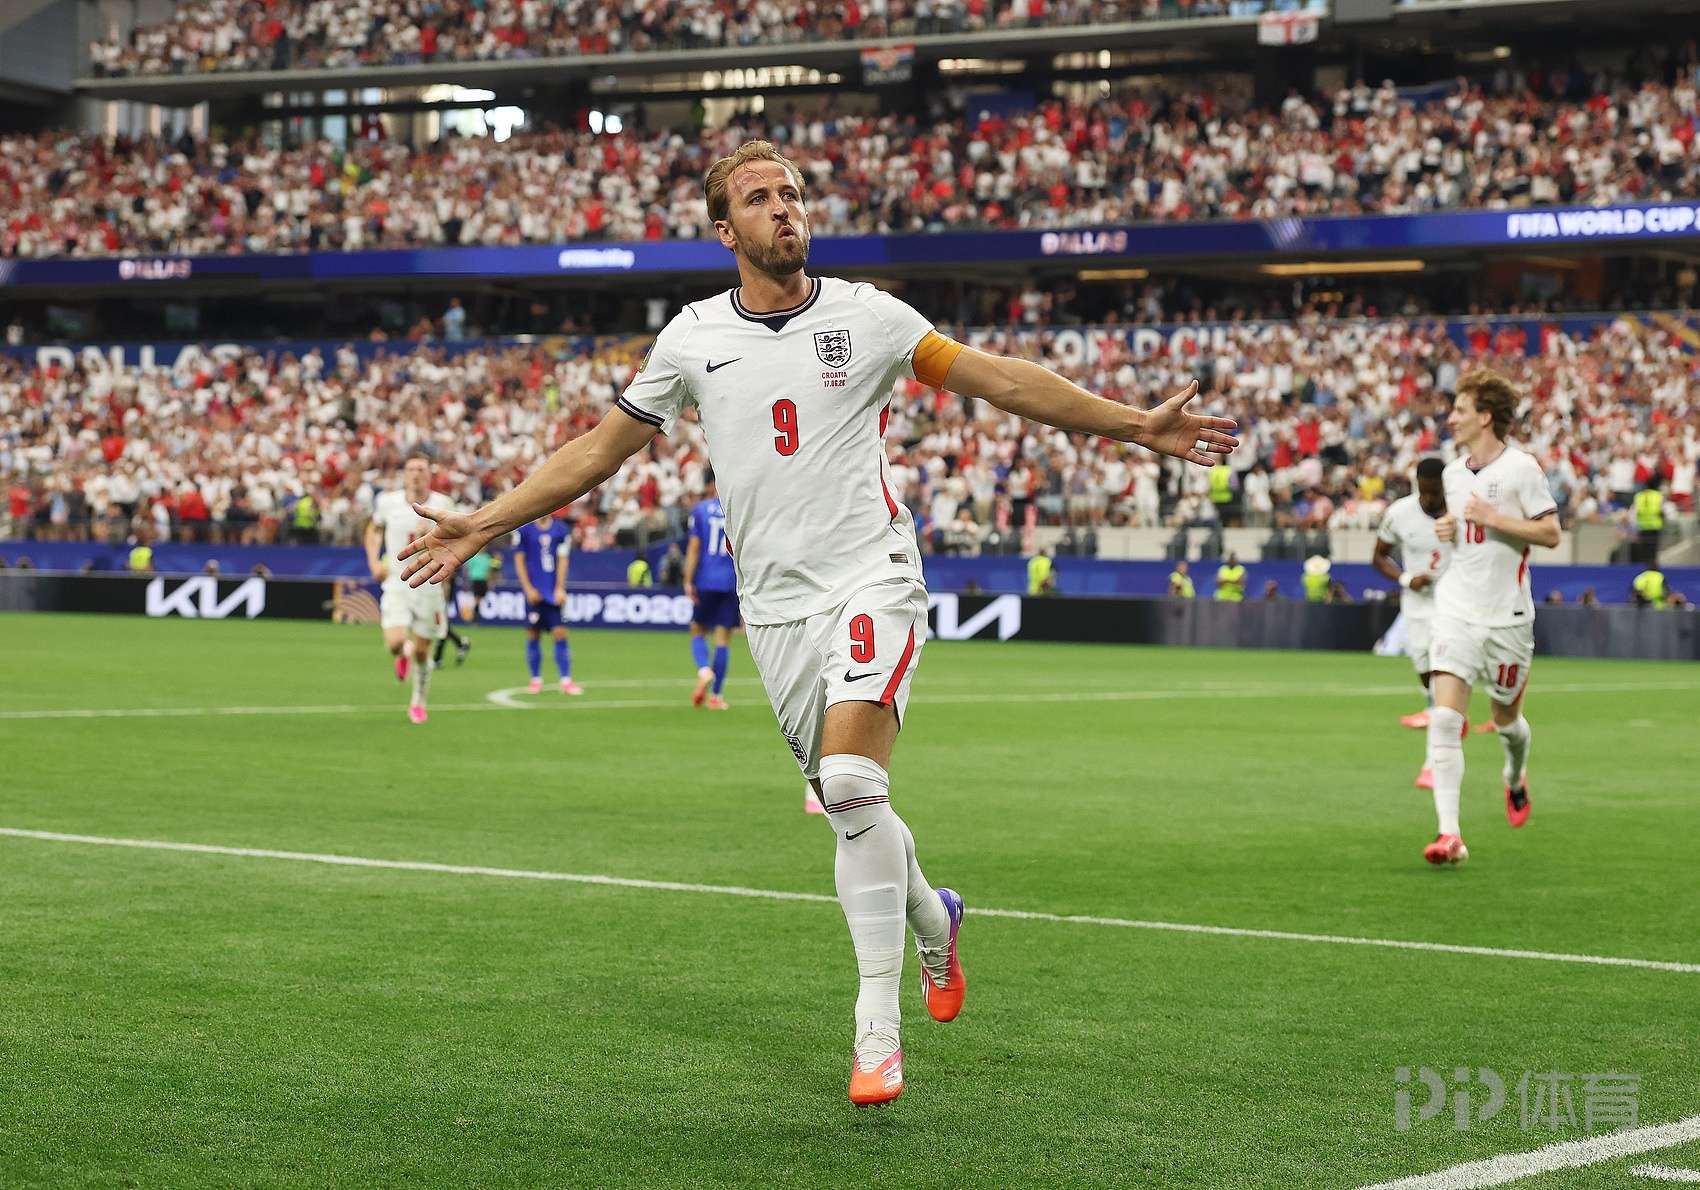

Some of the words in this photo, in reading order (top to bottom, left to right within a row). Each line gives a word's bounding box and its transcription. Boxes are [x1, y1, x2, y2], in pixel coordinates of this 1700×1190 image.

[1558, 208, 1644, 236] WORLD
[1645, 206, 1695, 233] CUP
[821, 371, 848, 379] CROATIA
[772, 399, 799, 456] 9
[1430, 550, 1440, 571] 2
[145, 576, 266, 620] KIA
[562, 593, 603, 622] UP
[602, 594, 694, 624] 2026
[849, 613, 875, 663] 9
[1498, 663, 1519, 689] 18
